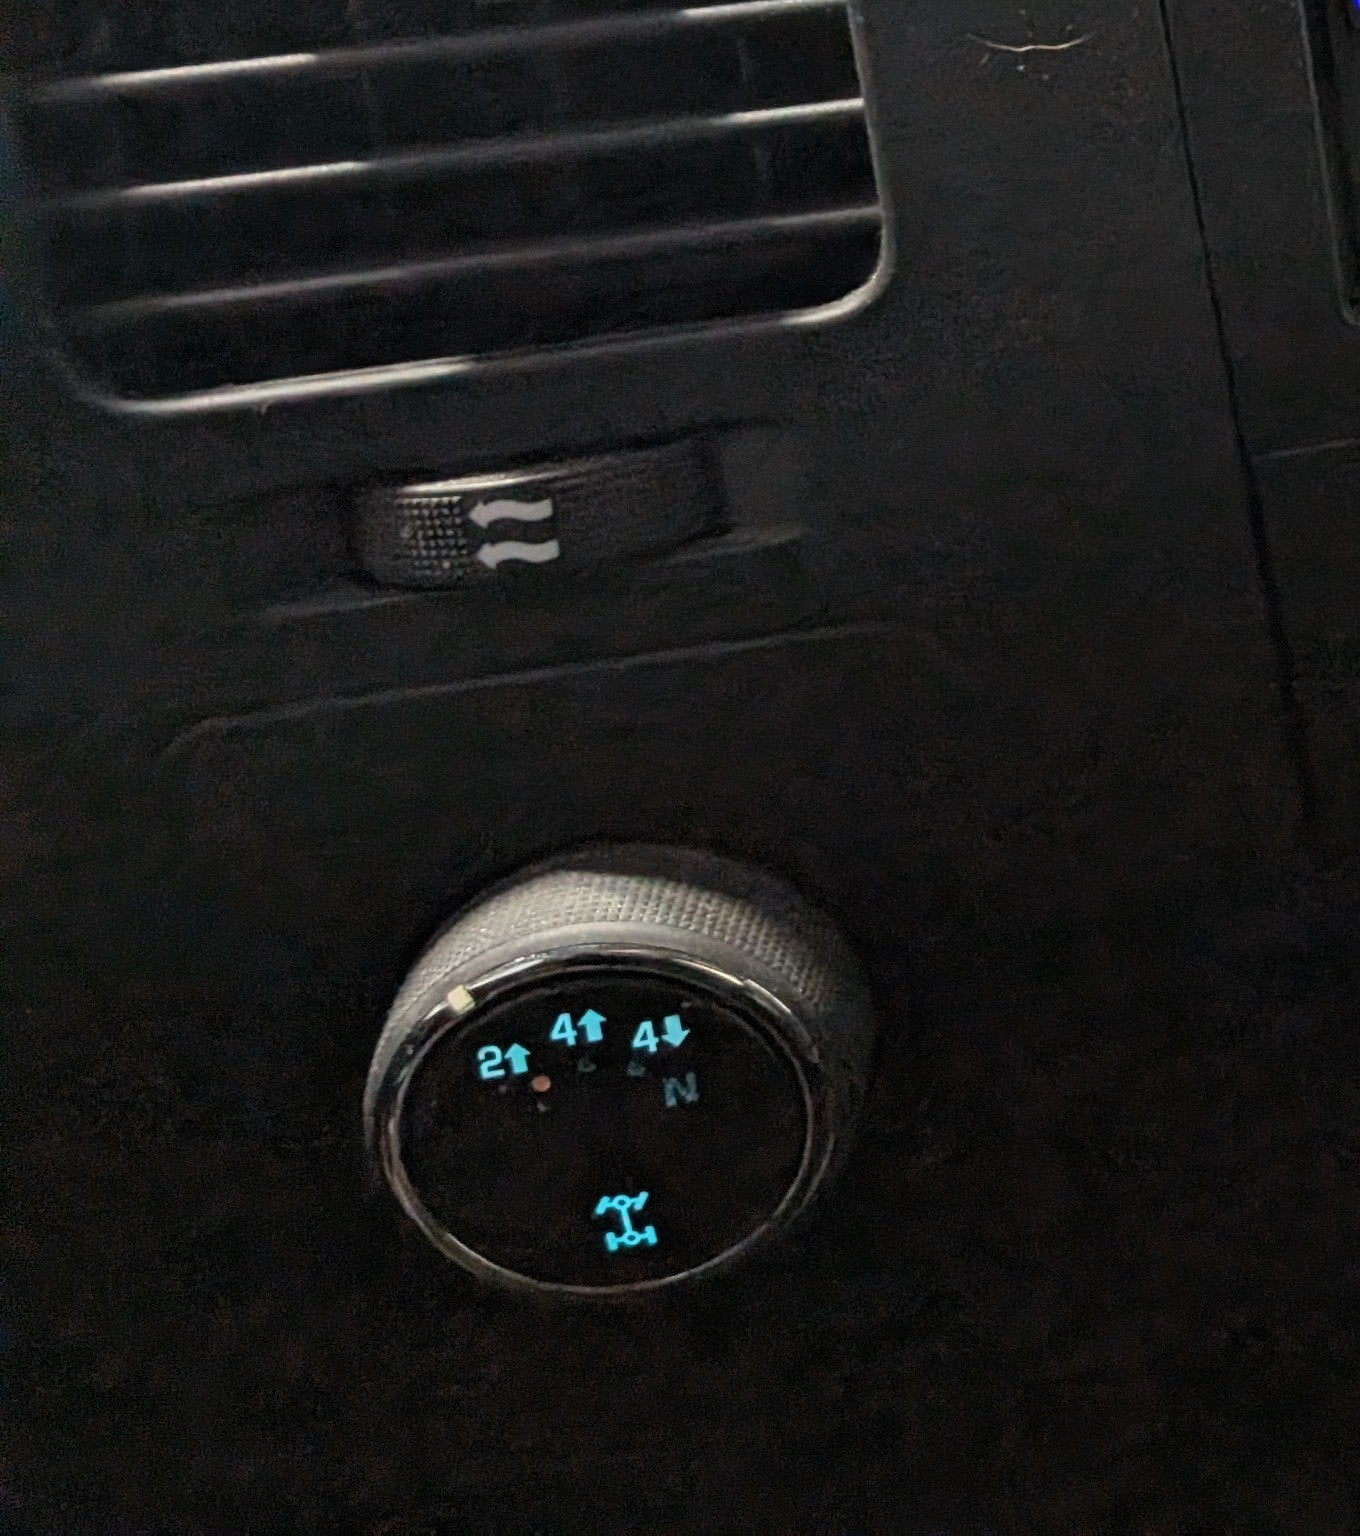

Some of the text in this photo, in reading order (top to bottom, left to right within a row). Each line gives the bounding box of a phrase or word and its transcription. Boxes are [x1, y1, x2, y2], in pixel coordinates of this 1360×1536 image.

[549, 1012, 577, 1045] 4
[631, 1020, 658, 1053] 4
[478, 1046, 505, 1080] 2
